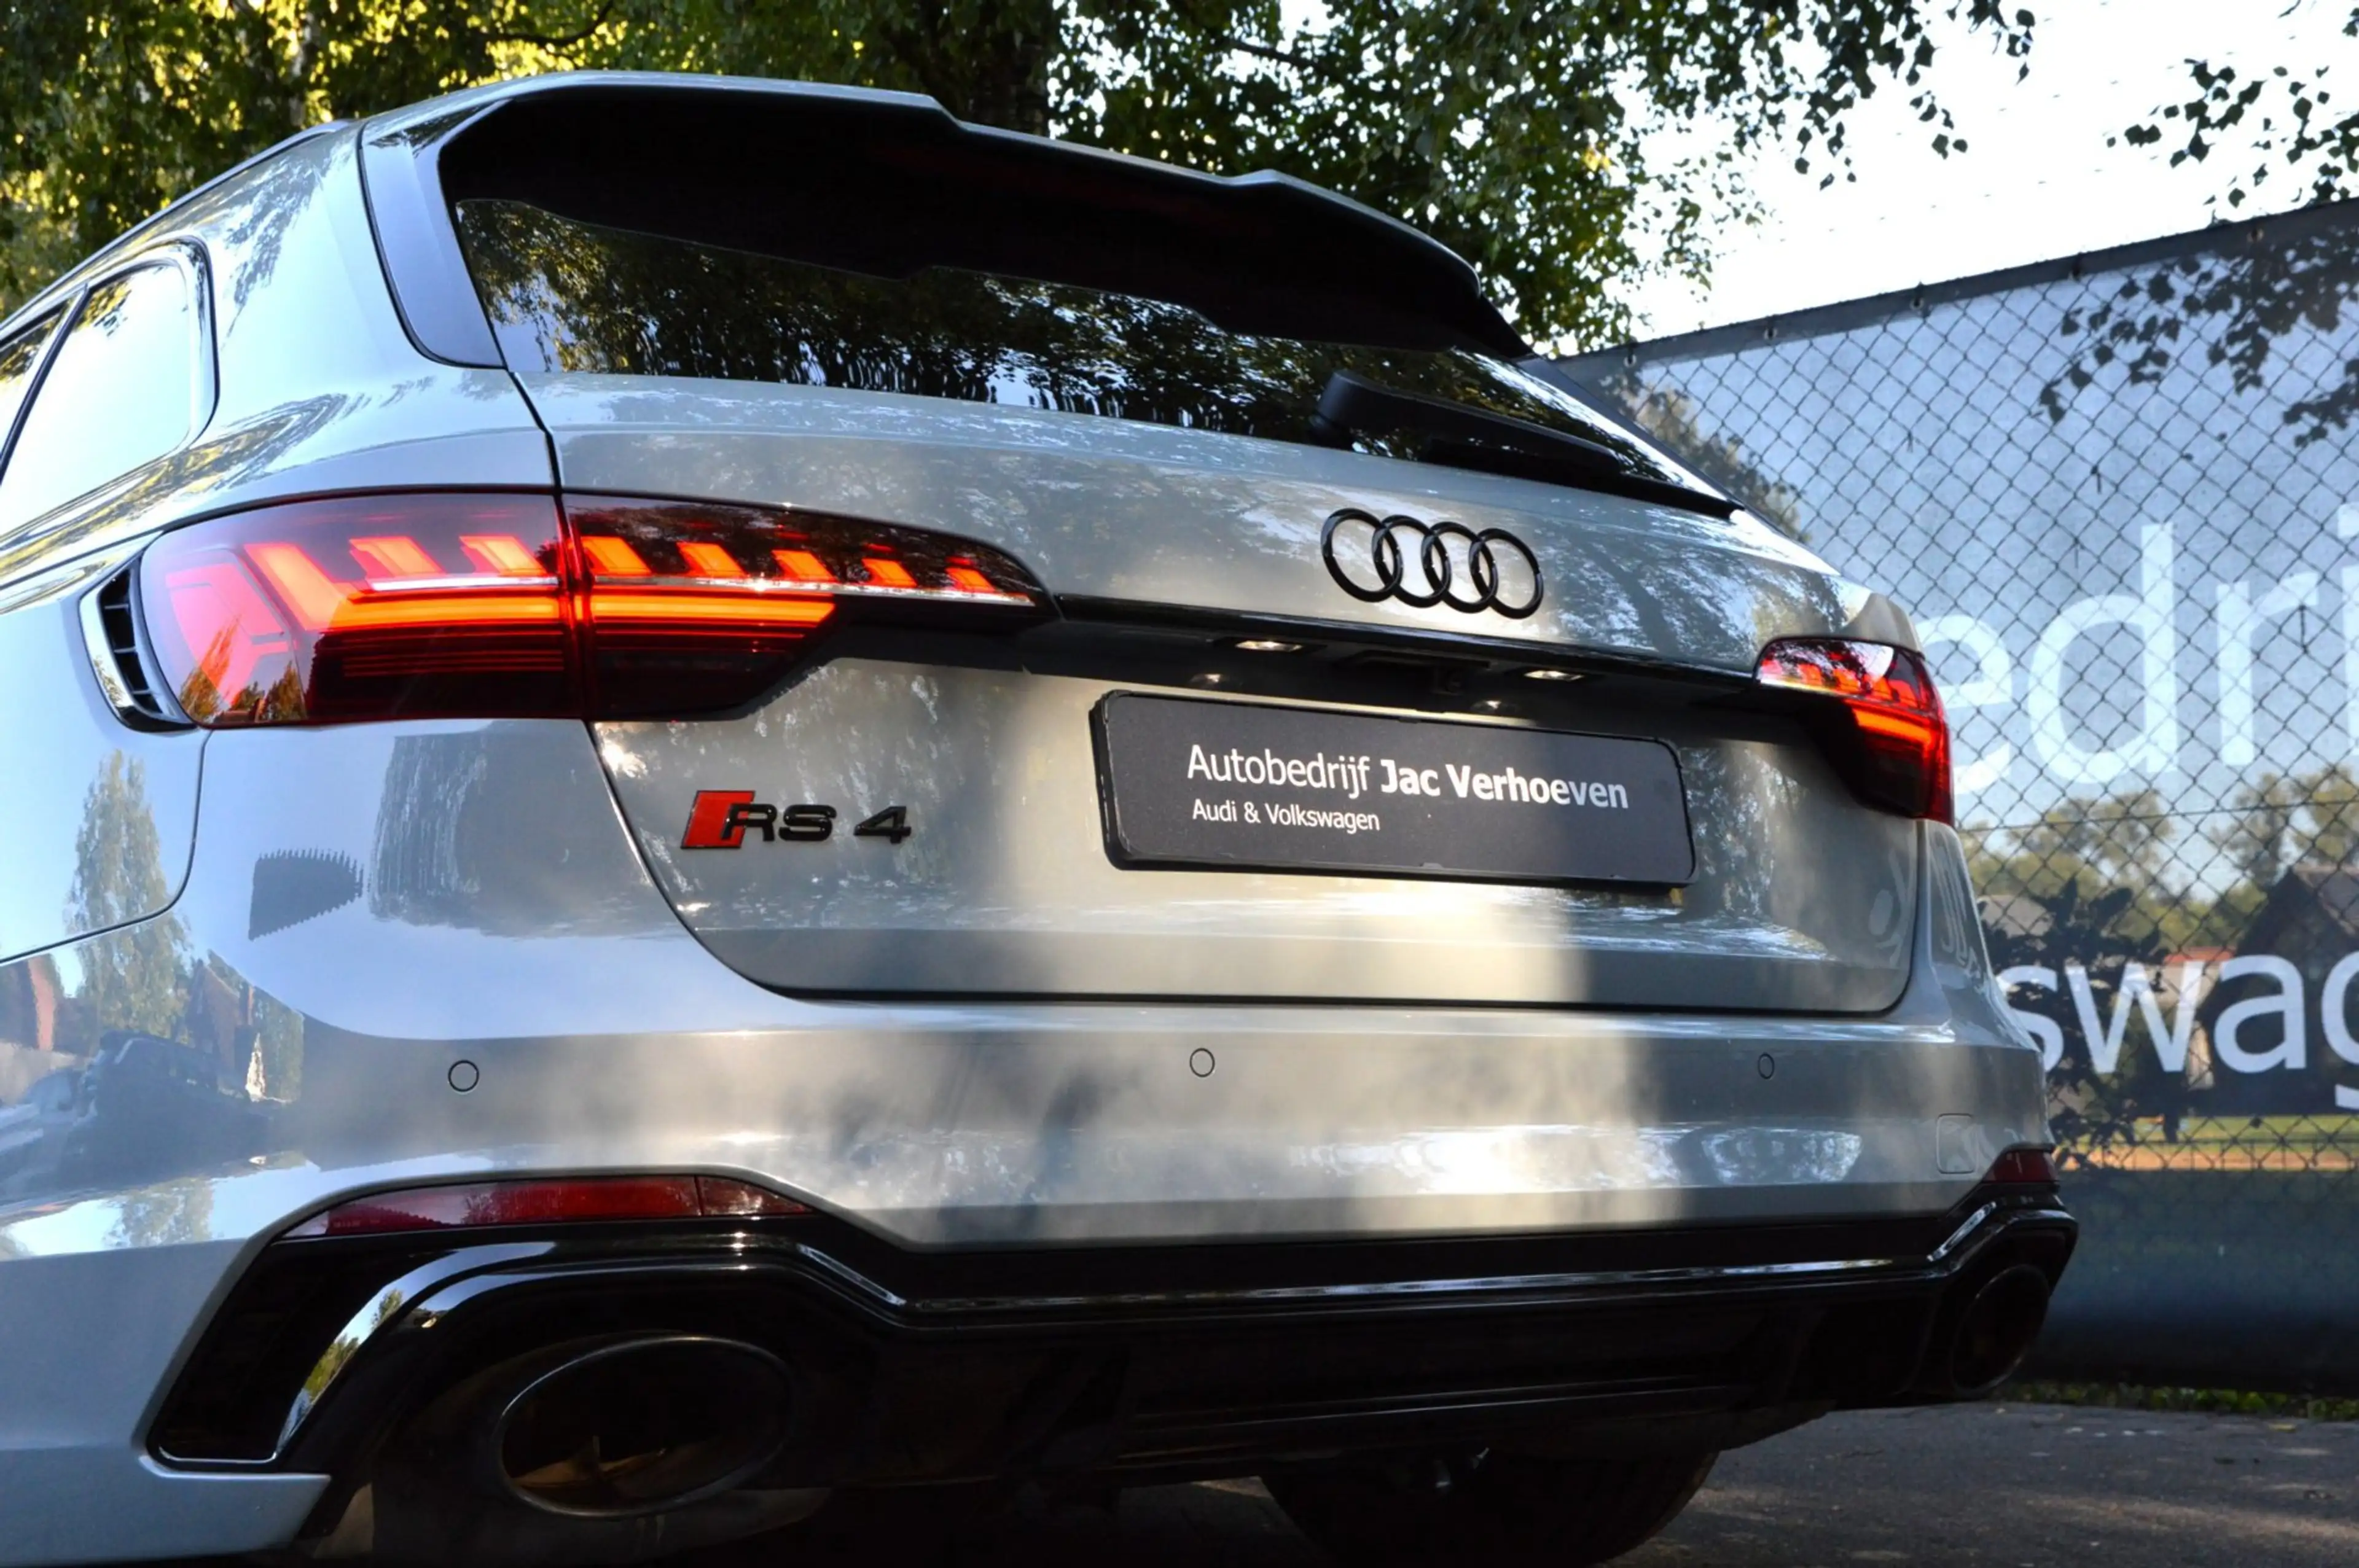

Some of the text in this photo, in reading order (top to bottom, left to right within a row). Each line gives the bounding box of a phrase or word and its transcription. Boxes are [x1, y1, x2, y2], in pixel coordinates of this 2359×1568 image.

[1187, 744, 1629, 809] Autobedrijf Jac Verhoeven
[719, 802, 912, 844] RS 4
[1192, 798, 1381, 835] Audi & Volkswagen
